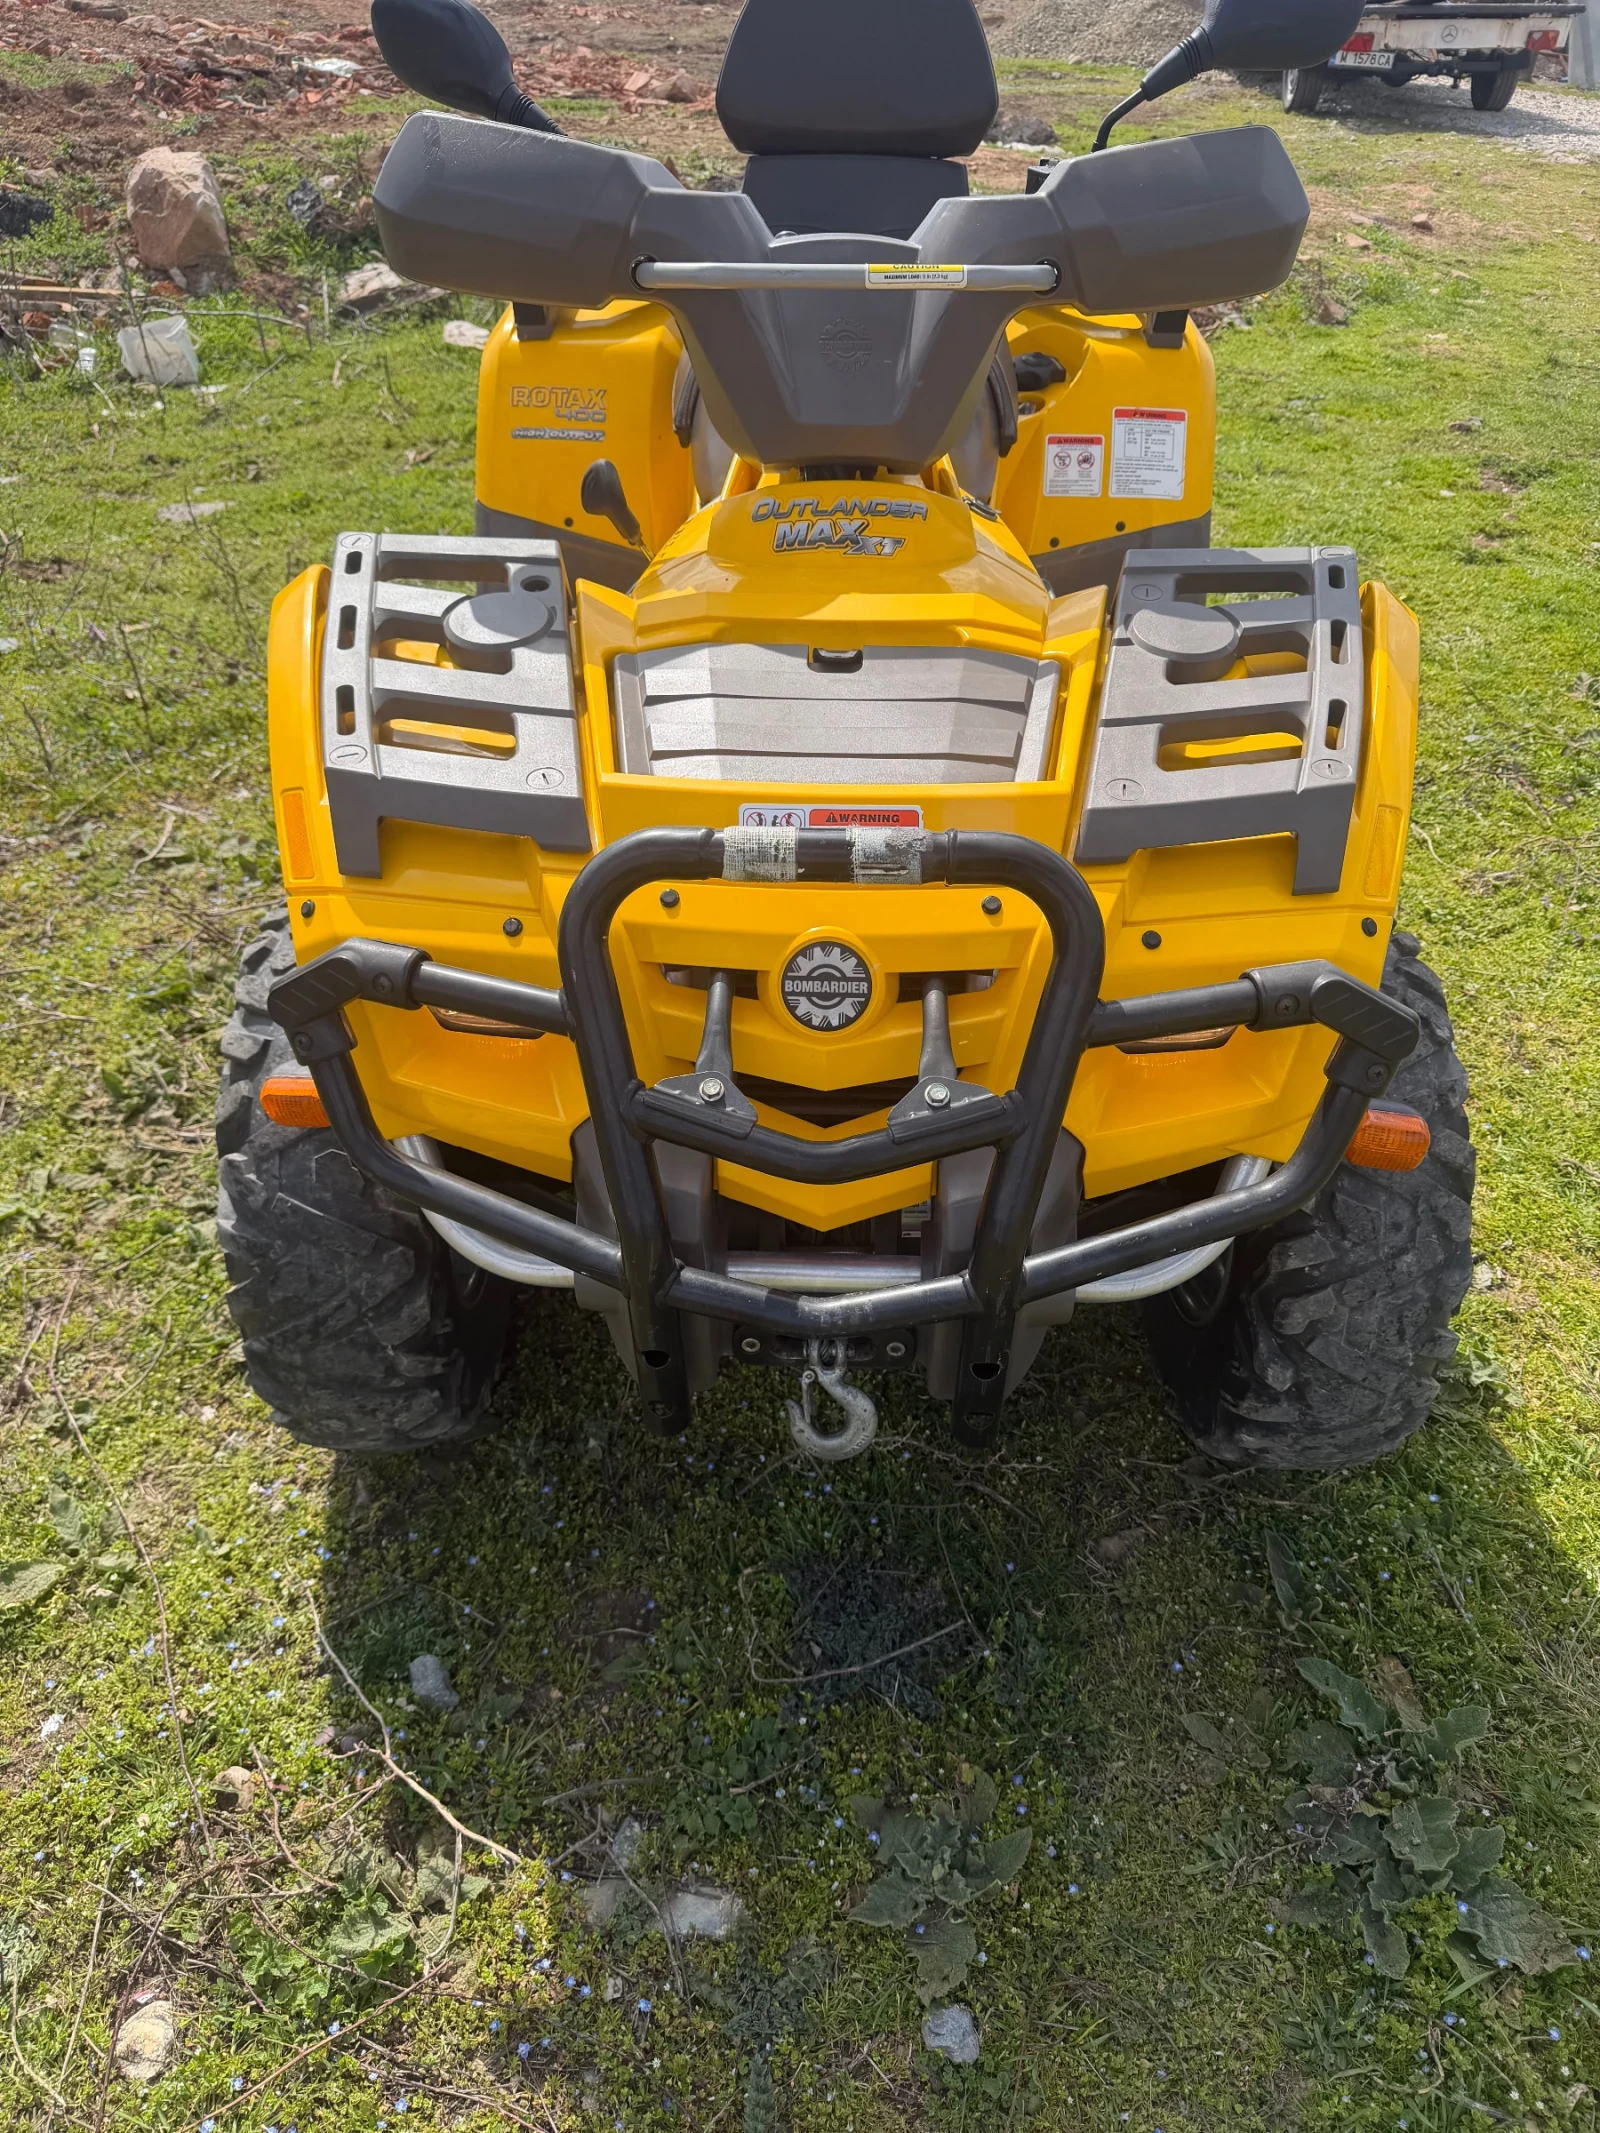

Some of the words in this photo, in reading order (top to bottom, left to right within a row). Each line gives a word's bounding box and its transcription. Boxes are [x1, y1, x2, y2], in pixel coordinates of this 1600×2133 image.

[1340, 51, 1348, 63] M
[1354, 53, 1376, 65] 1578
[1377, 54, 1391, 67] CA
[511, 386, 607, 410] ROTAX
[554, 408, 606, 423] 400
[751, 497, 928, 522] OUTLANDER
[774, 519, 869, 552] MAX
[843, 535, 906, 556] XT
[839, 813, 900, 823] WARNING
[785, 980, 868, 994] BOMBARDIER
